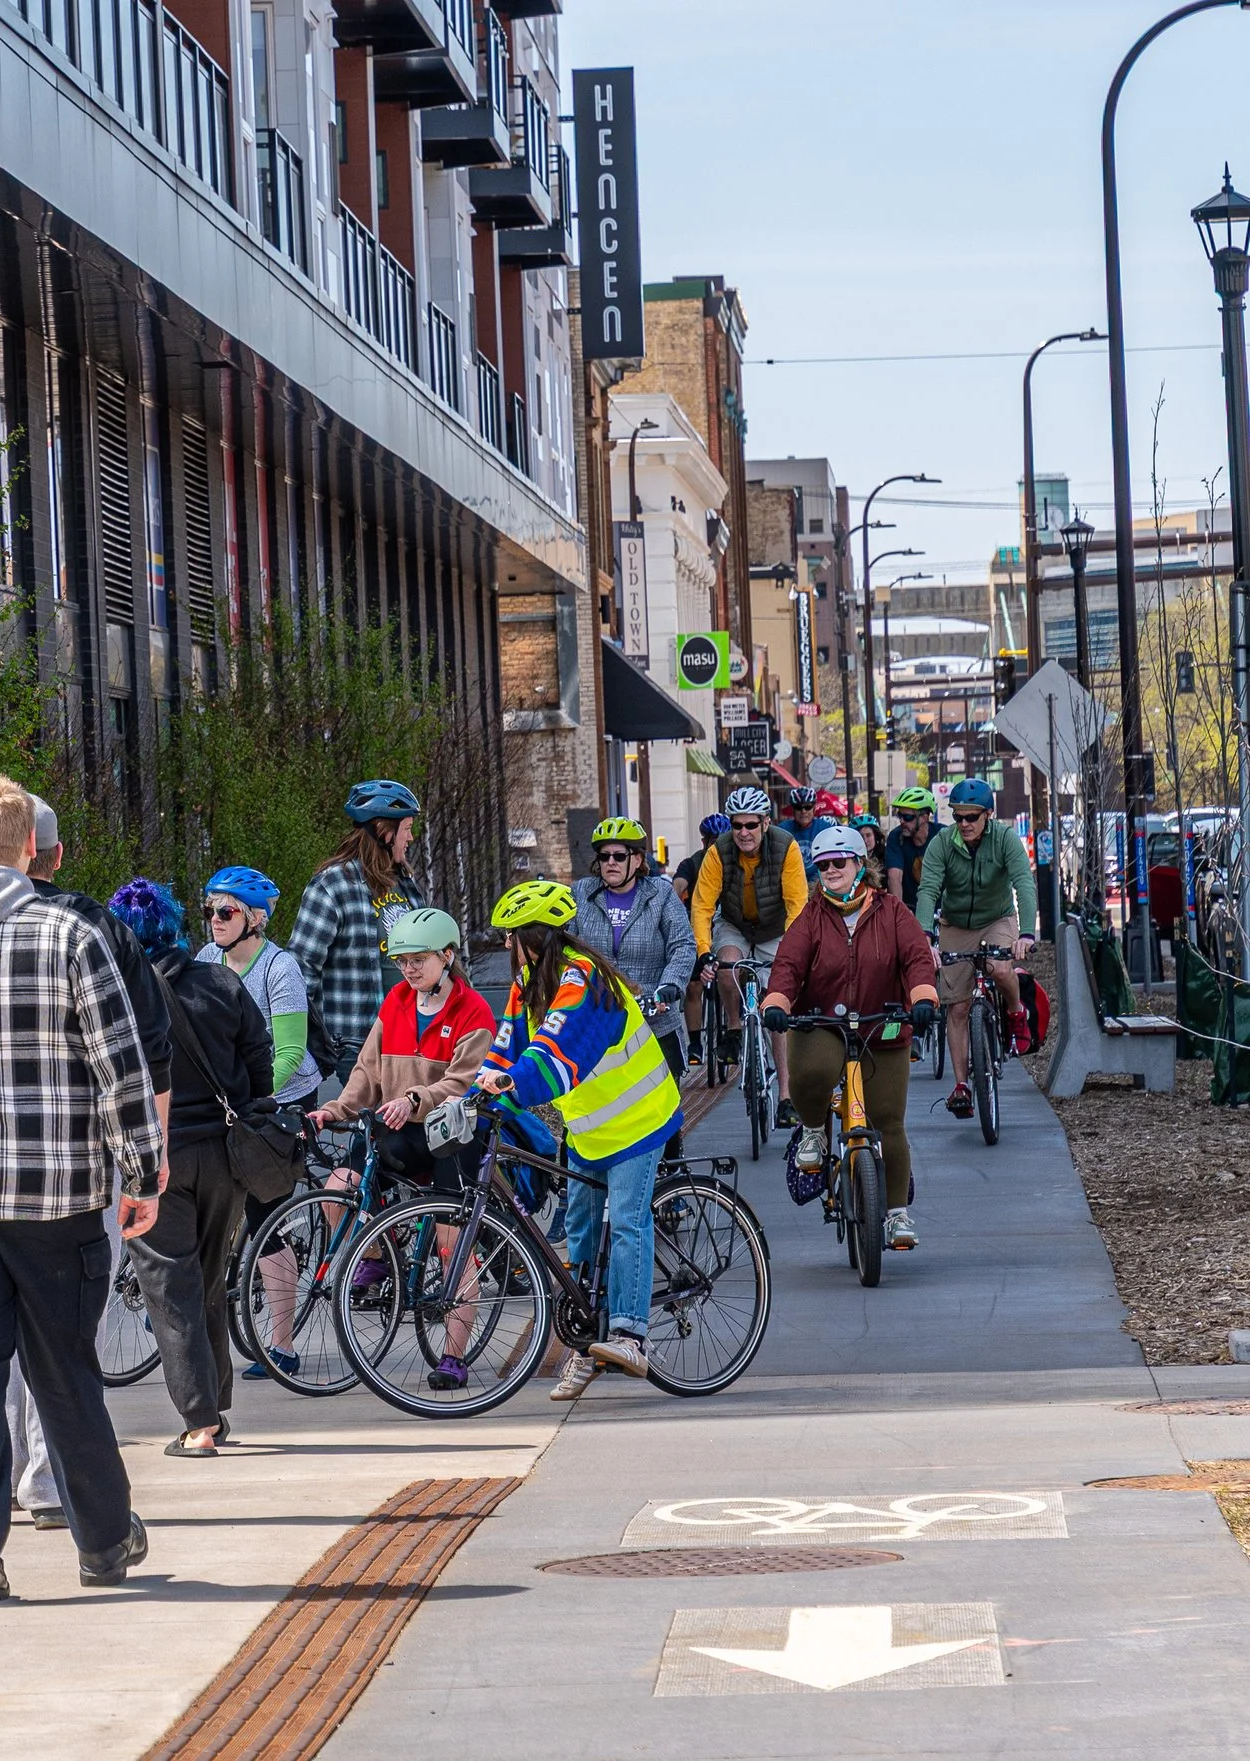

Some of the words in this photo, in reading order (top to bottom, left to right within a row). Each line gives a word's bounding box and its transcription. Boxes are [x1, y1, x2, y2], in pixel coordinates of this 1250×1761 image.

[627, 541, 639, 586] OLD
[629, 592, 642, 652] TOWN
[683, 652, 715, 667] masu
[751, 727, 767, 739] CITY
[729, 750, 747, 760] SA
[730, 760, 747, 769] LA
